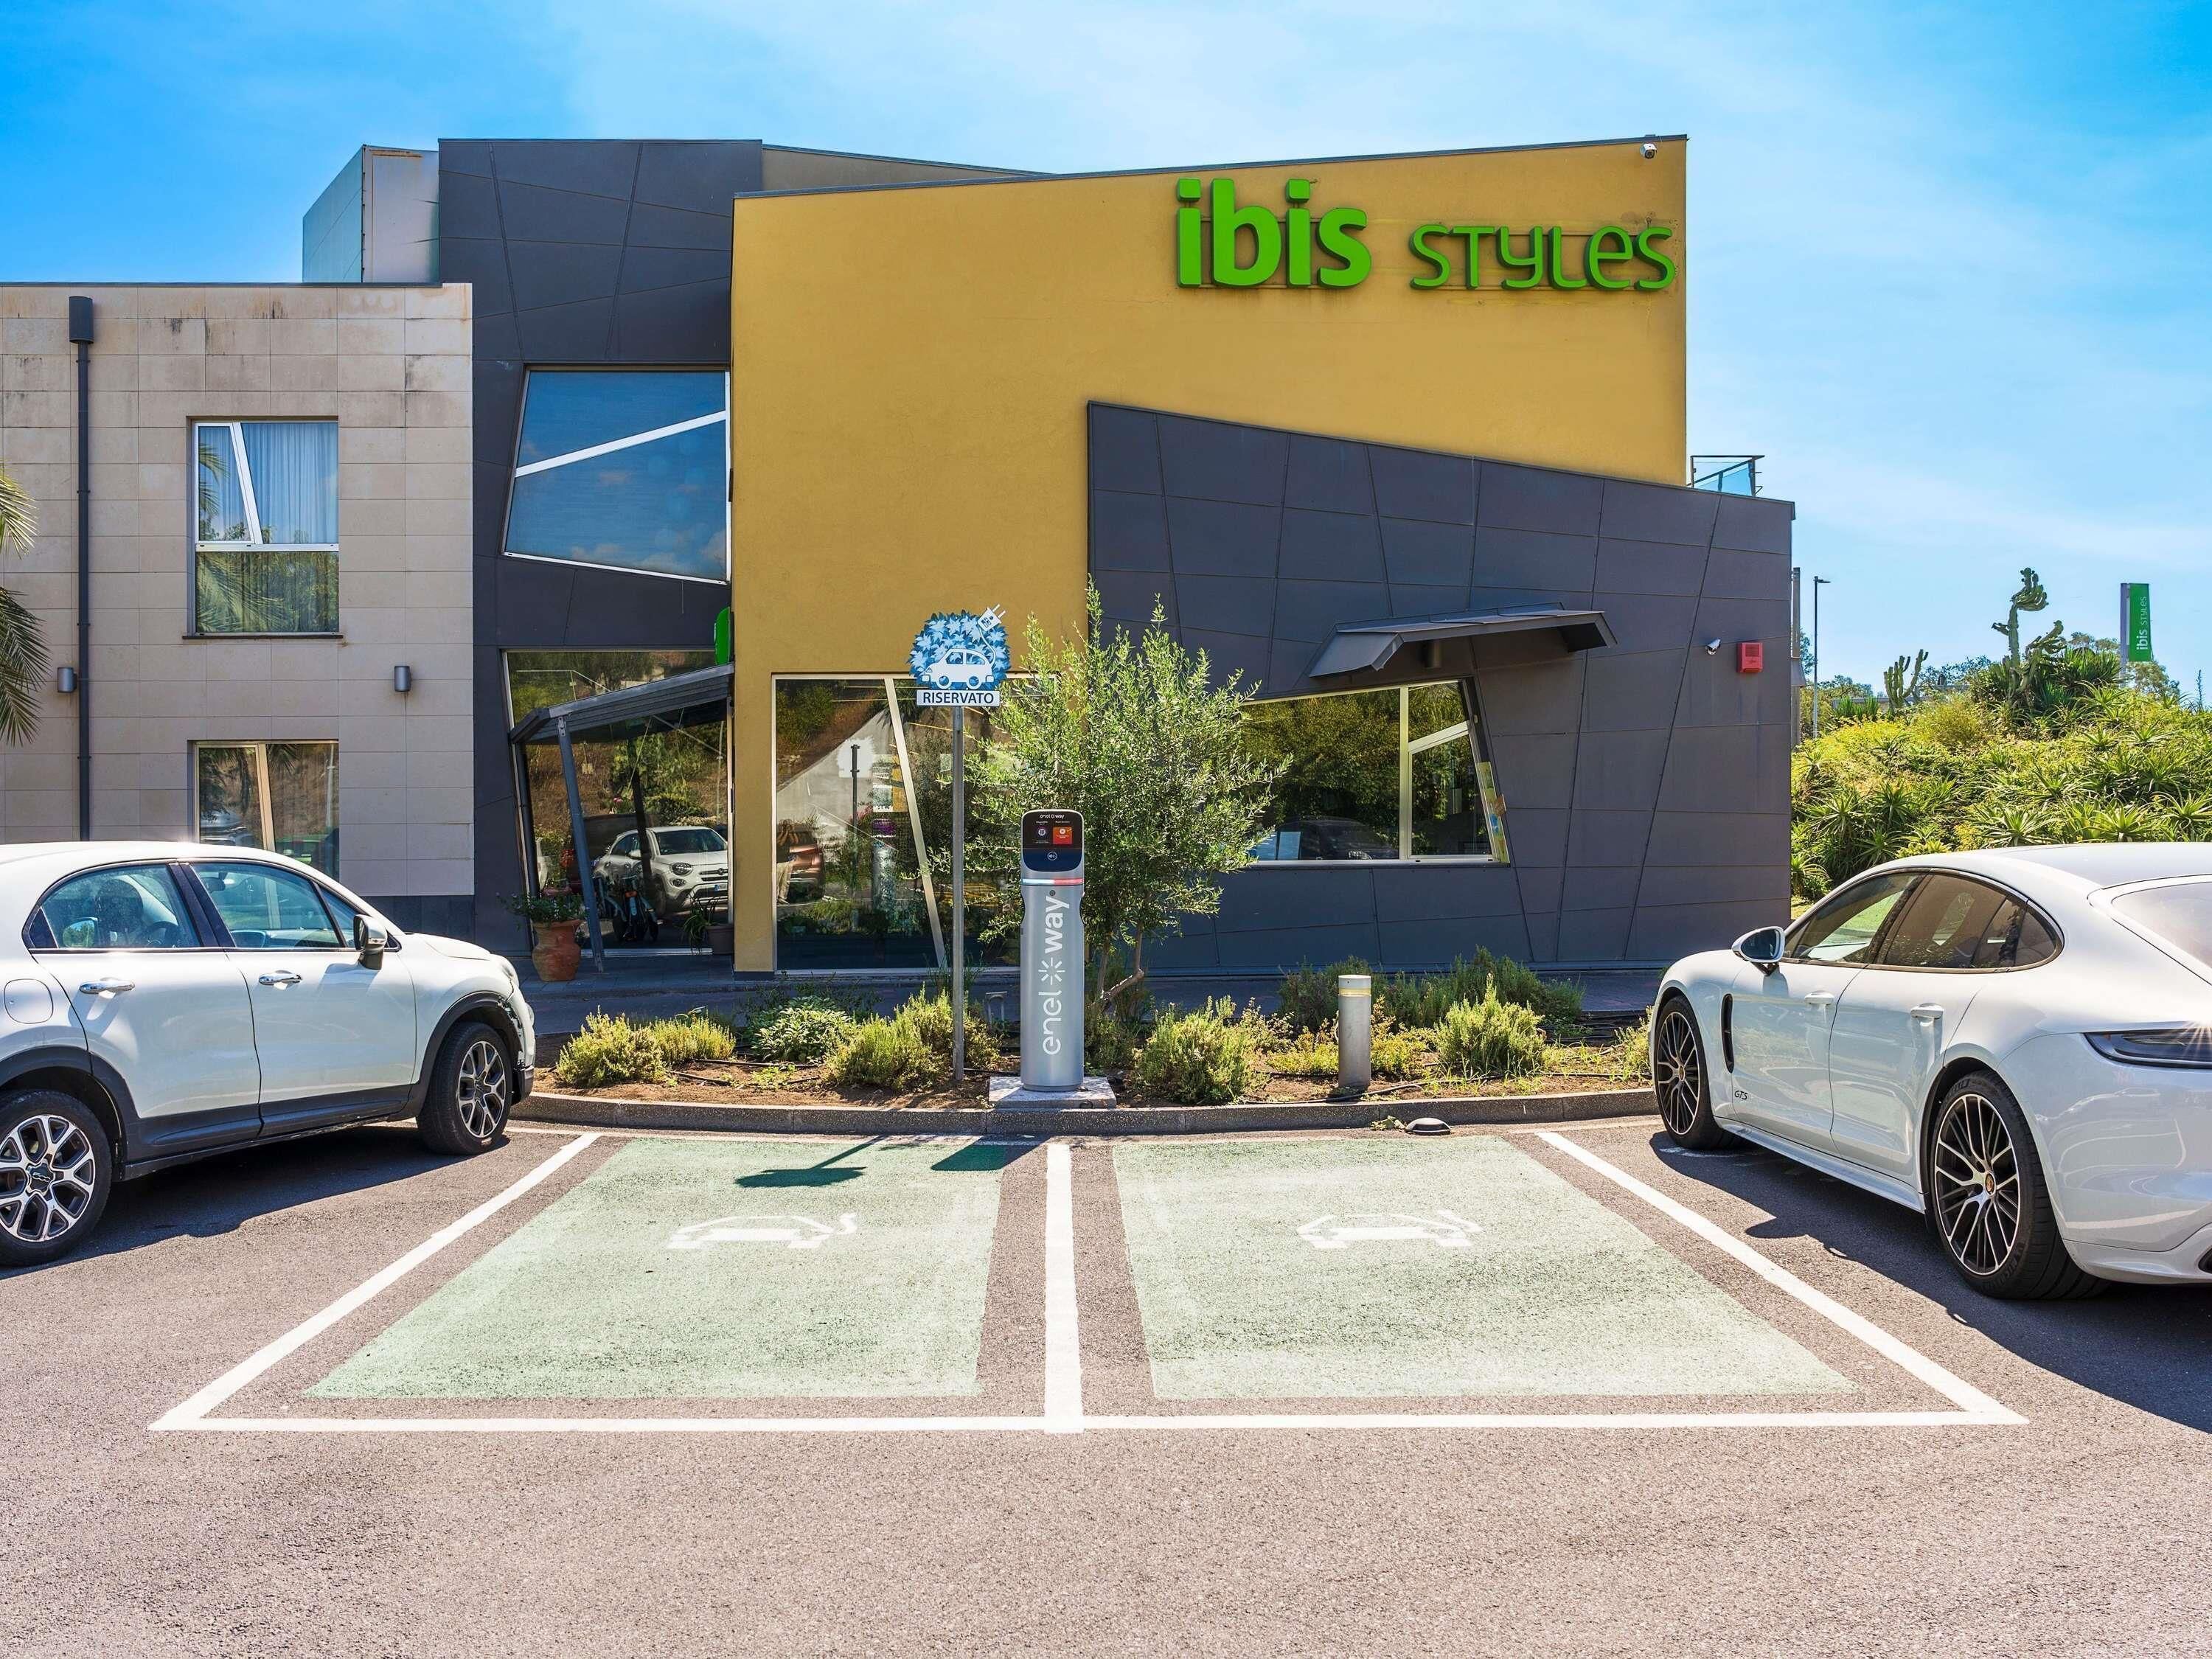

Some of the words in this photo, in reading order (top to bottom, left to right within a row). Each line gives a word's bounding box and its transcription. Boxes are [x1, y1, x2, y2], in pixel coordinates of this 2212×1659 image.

[1176, 178, 1372, 289] ibis
[2136, 628, 2148, 650] ibis
[923, 692, 994, 703] RISERVATO
[1045, 896, 1069, 953] way
[1038, 990, 1062, 1055] enel
[1734, 1091, 1747, 1100] GTS
